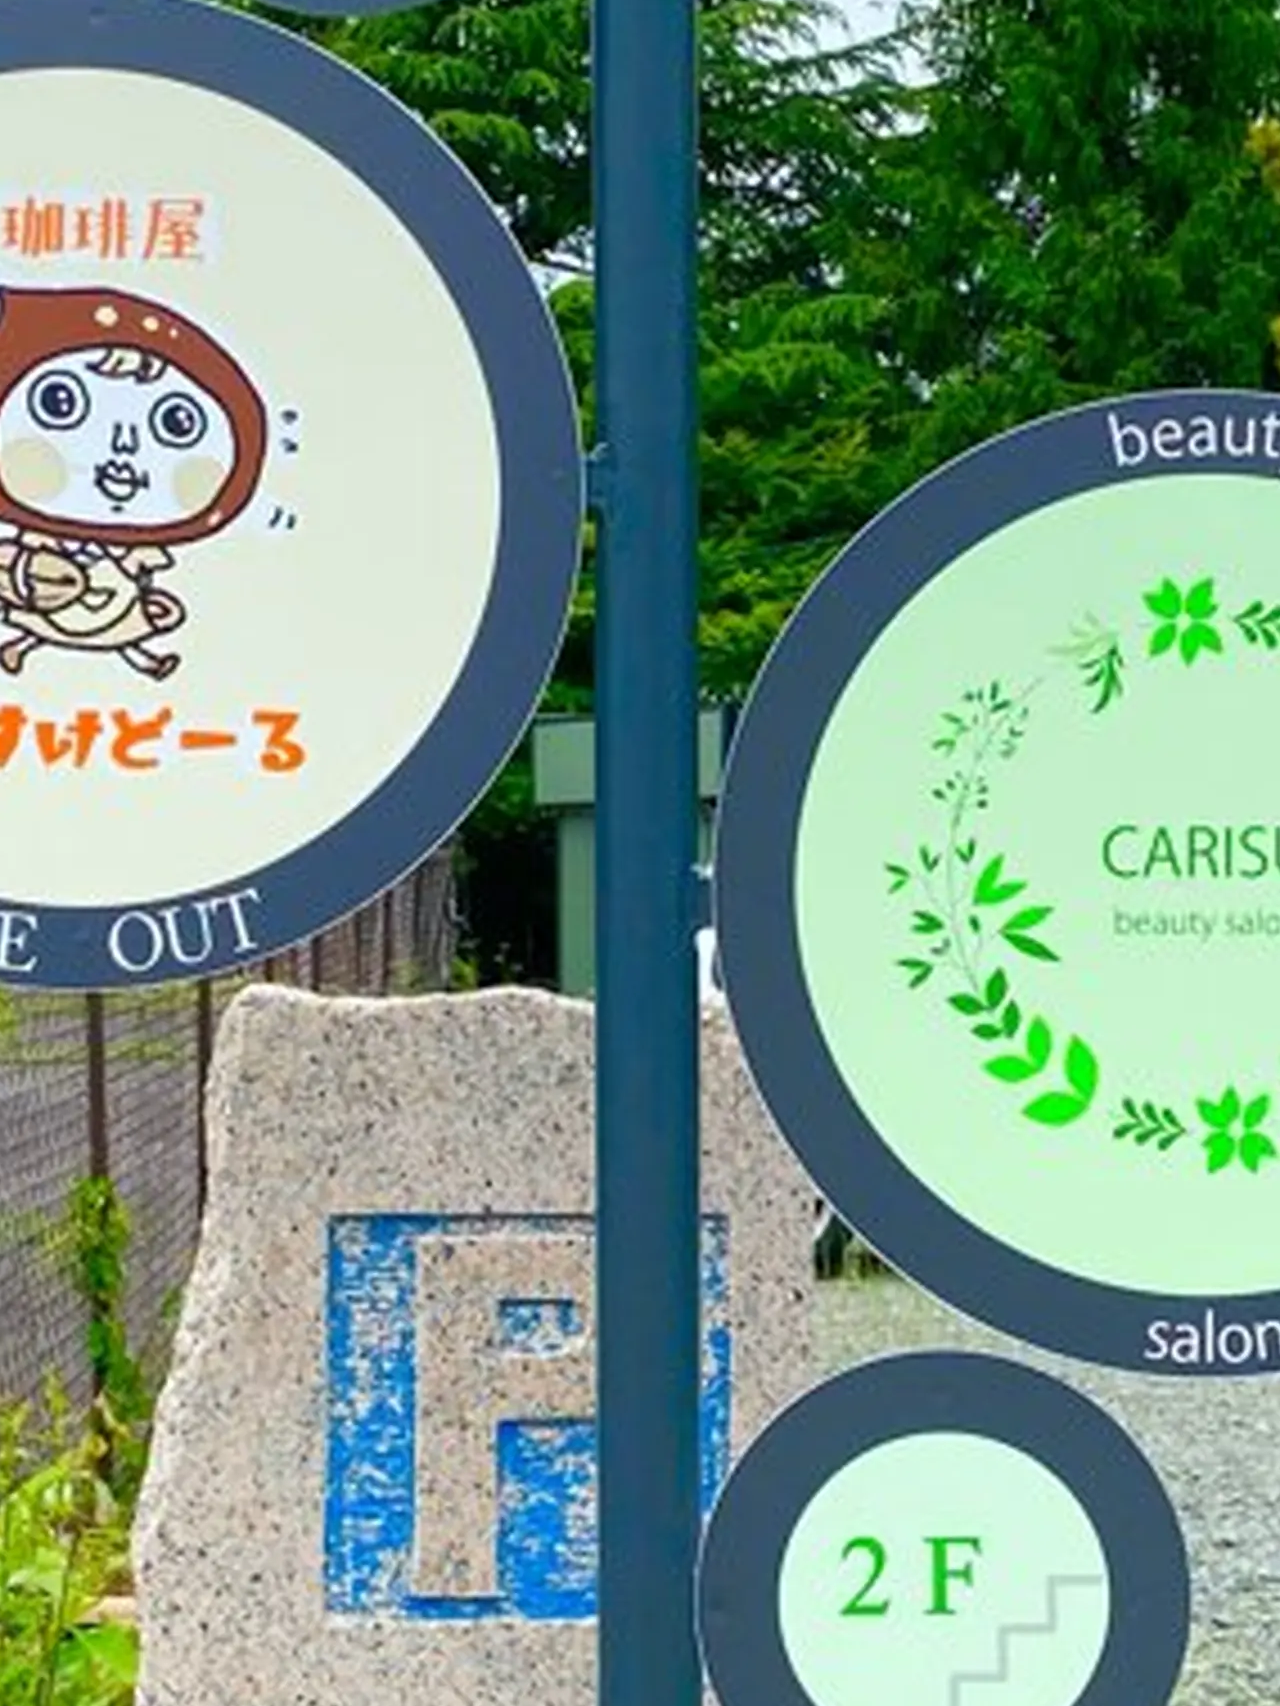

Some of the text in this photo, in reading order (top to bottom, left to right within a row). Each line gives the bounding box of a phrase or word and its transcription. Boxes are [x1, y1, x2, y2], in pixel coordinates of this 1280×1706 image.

[1, 194, 204, 260] 珈琲屋
[107, 887, 261, 973] OUT
[1113, 907, 1218, 943] beauty
